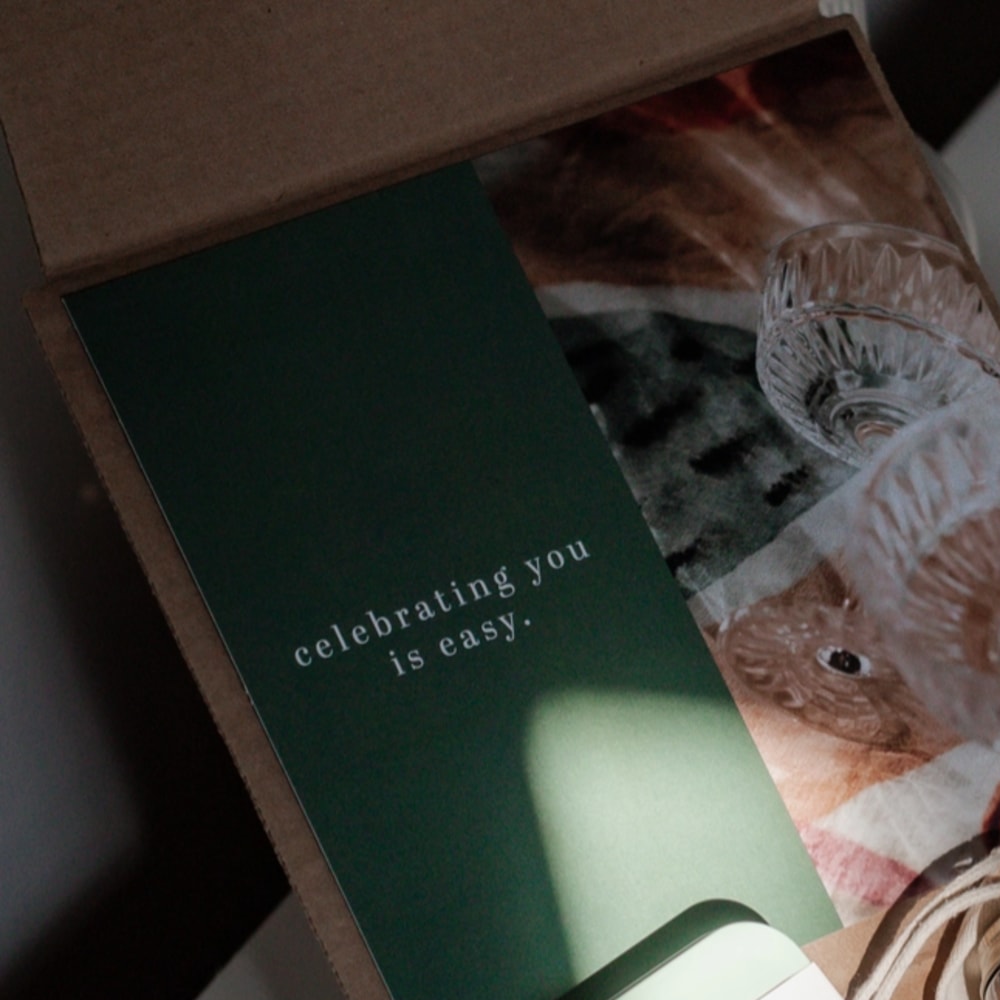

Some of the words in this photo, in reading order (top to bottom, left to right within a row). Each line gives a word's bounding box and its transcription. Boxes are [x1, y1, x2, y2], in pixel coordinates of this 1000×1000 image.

[293, 565, 517, 667] celebrating
[524, 539, 591, 586] you
[388, 649, 425, 677] is
[439, 611, 531, 658] easy.
